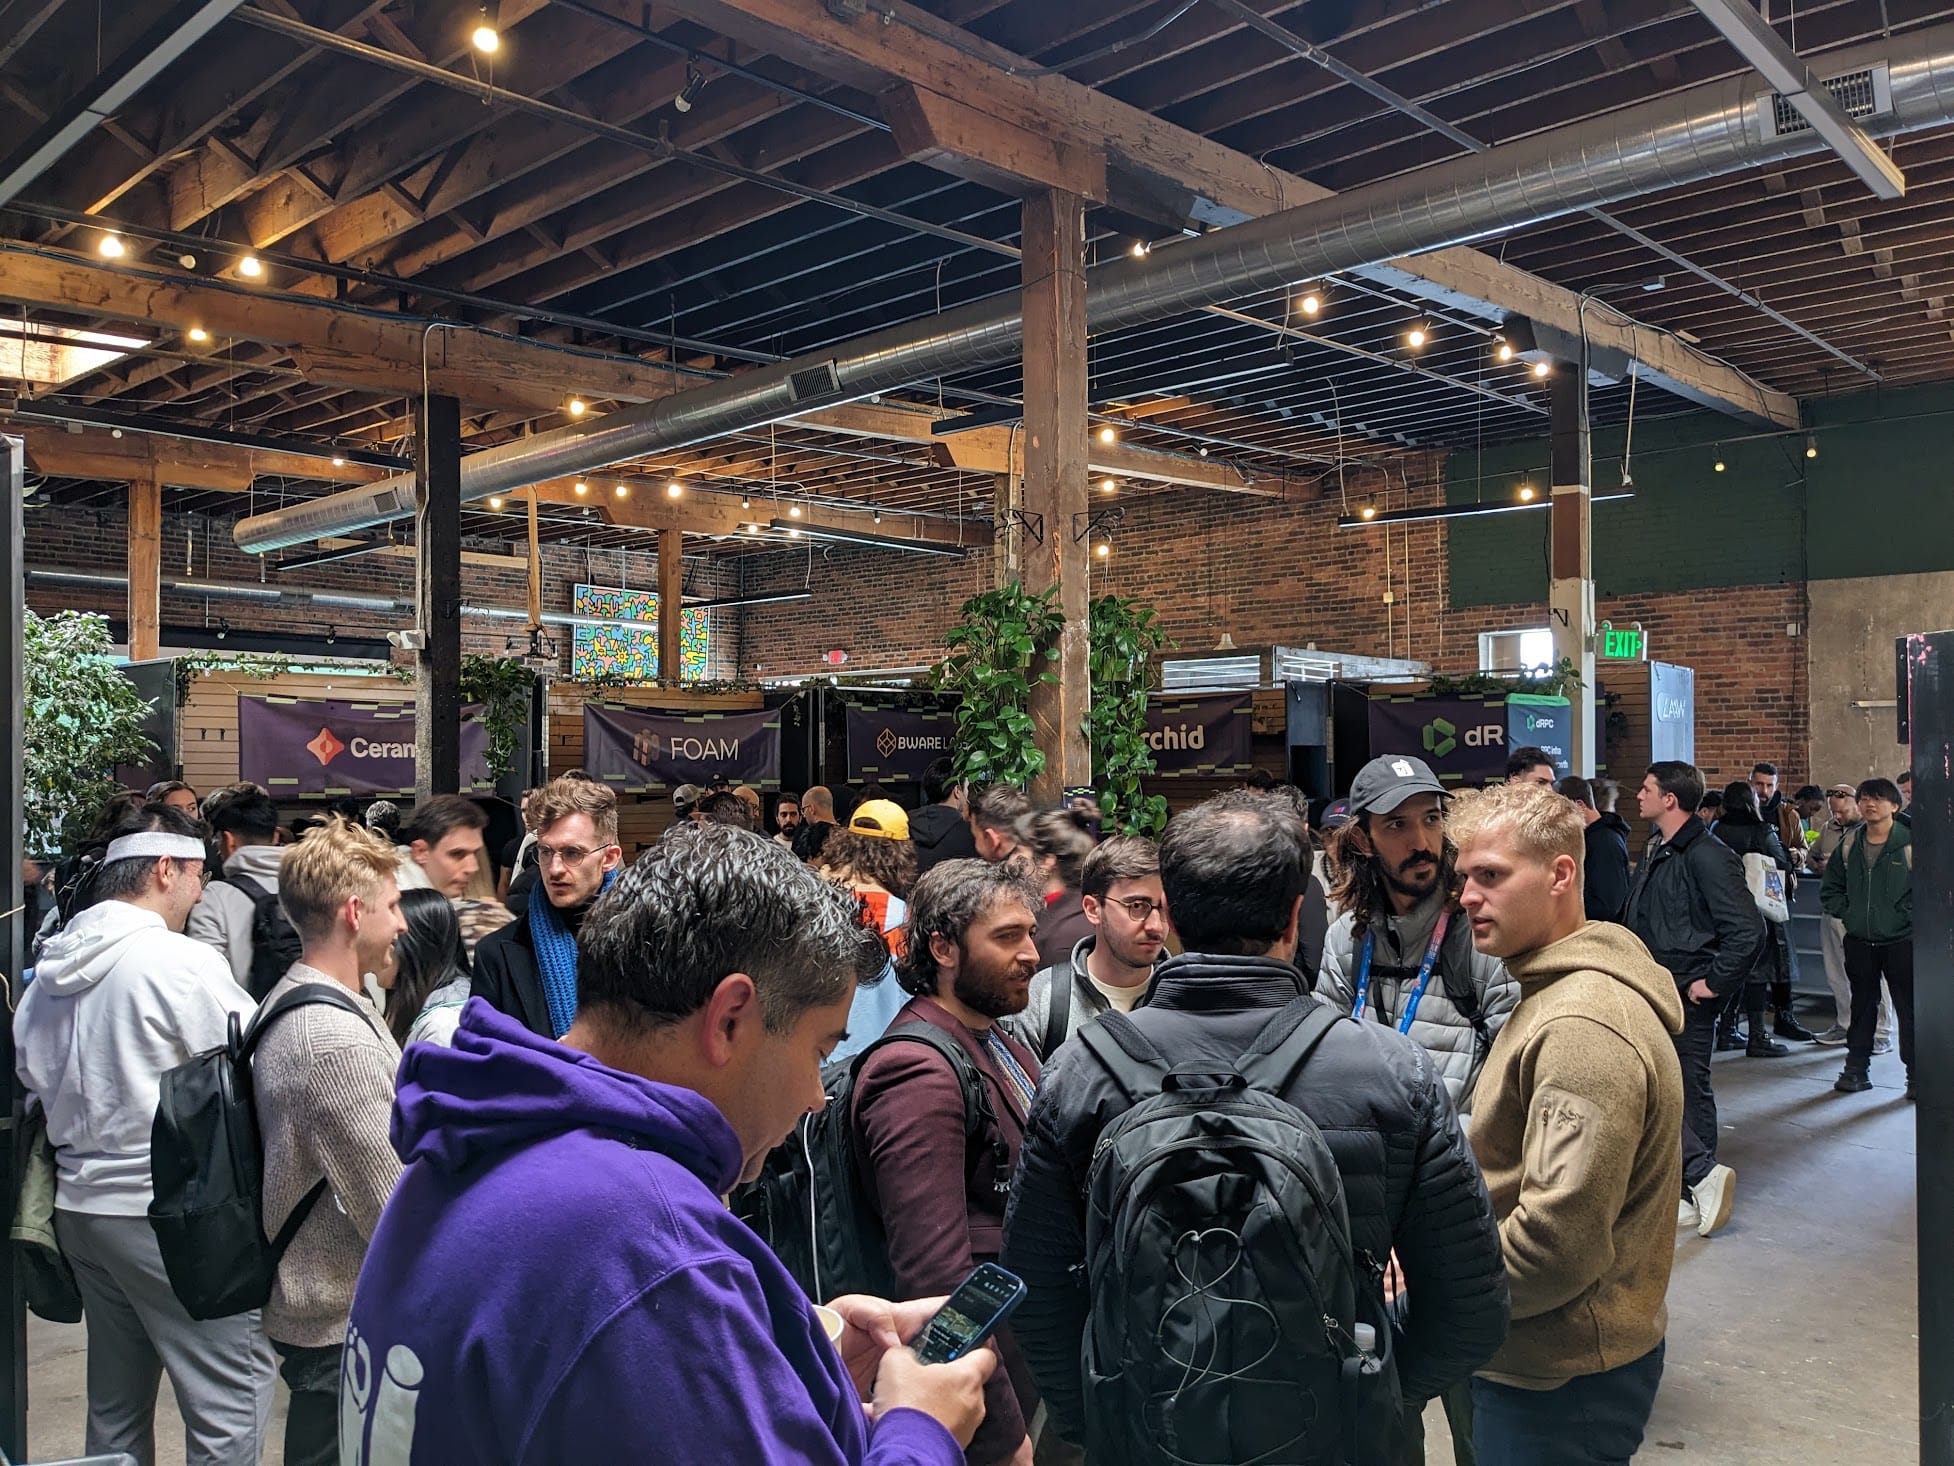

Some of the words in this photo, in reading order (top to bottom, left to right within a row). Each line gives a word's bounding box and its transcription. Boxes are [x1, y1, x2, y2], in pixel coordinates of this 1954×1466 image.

[1605, 631, 1638, 657] EXIT
[1536, 719, 1554, 729] dRPC
[898, 736, 941, 750] BWARE
[1140, 724, 1205, 750] rchid
[1464, 725, 1504, 746] dR
[671, 737, 739, 760] FOAM
